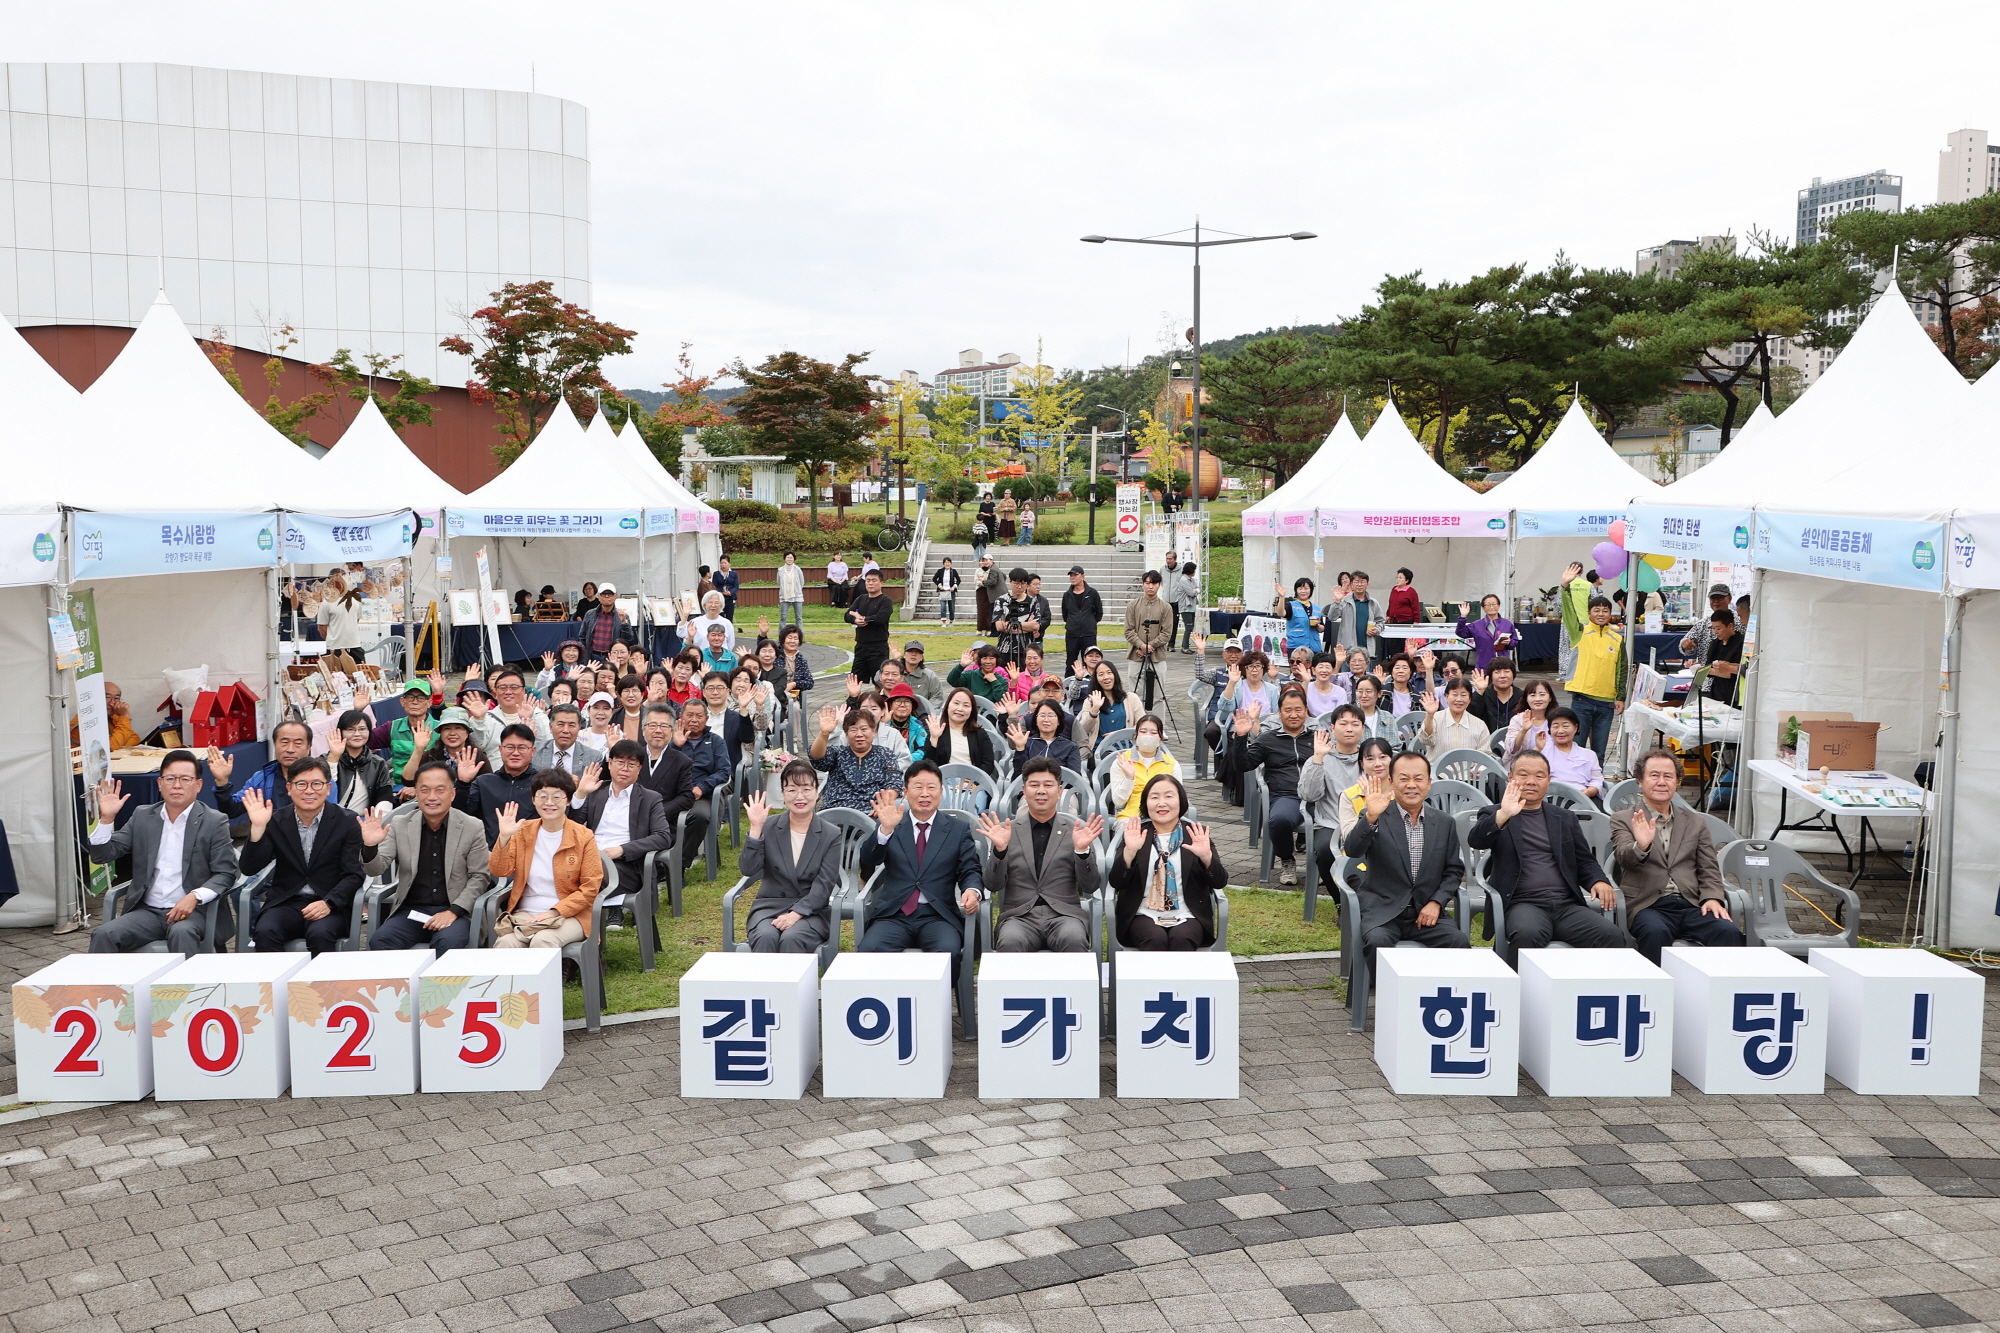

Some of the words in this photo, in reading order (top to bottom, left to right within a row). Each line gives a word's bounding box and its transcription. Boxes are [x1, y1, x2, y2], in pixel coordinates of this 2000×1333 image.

[484, 514, 524, 525] 마음으로
[527, 515, 557, 525] 피우는
[560, 516, 570, 526] 꽃
[573, 516, 603, 526] 그리기
[1663, 517, 1684, 536] 위대한
[1686, 519, 1701, 537] 탄생
[162, 524, 216, 546] 목수사랑방
[1801, 528, 1873, 555] 설악마을공동체
[52, 997, 506, 1077] 2025
[1419, 986, 1933, 1078] 한마당!
